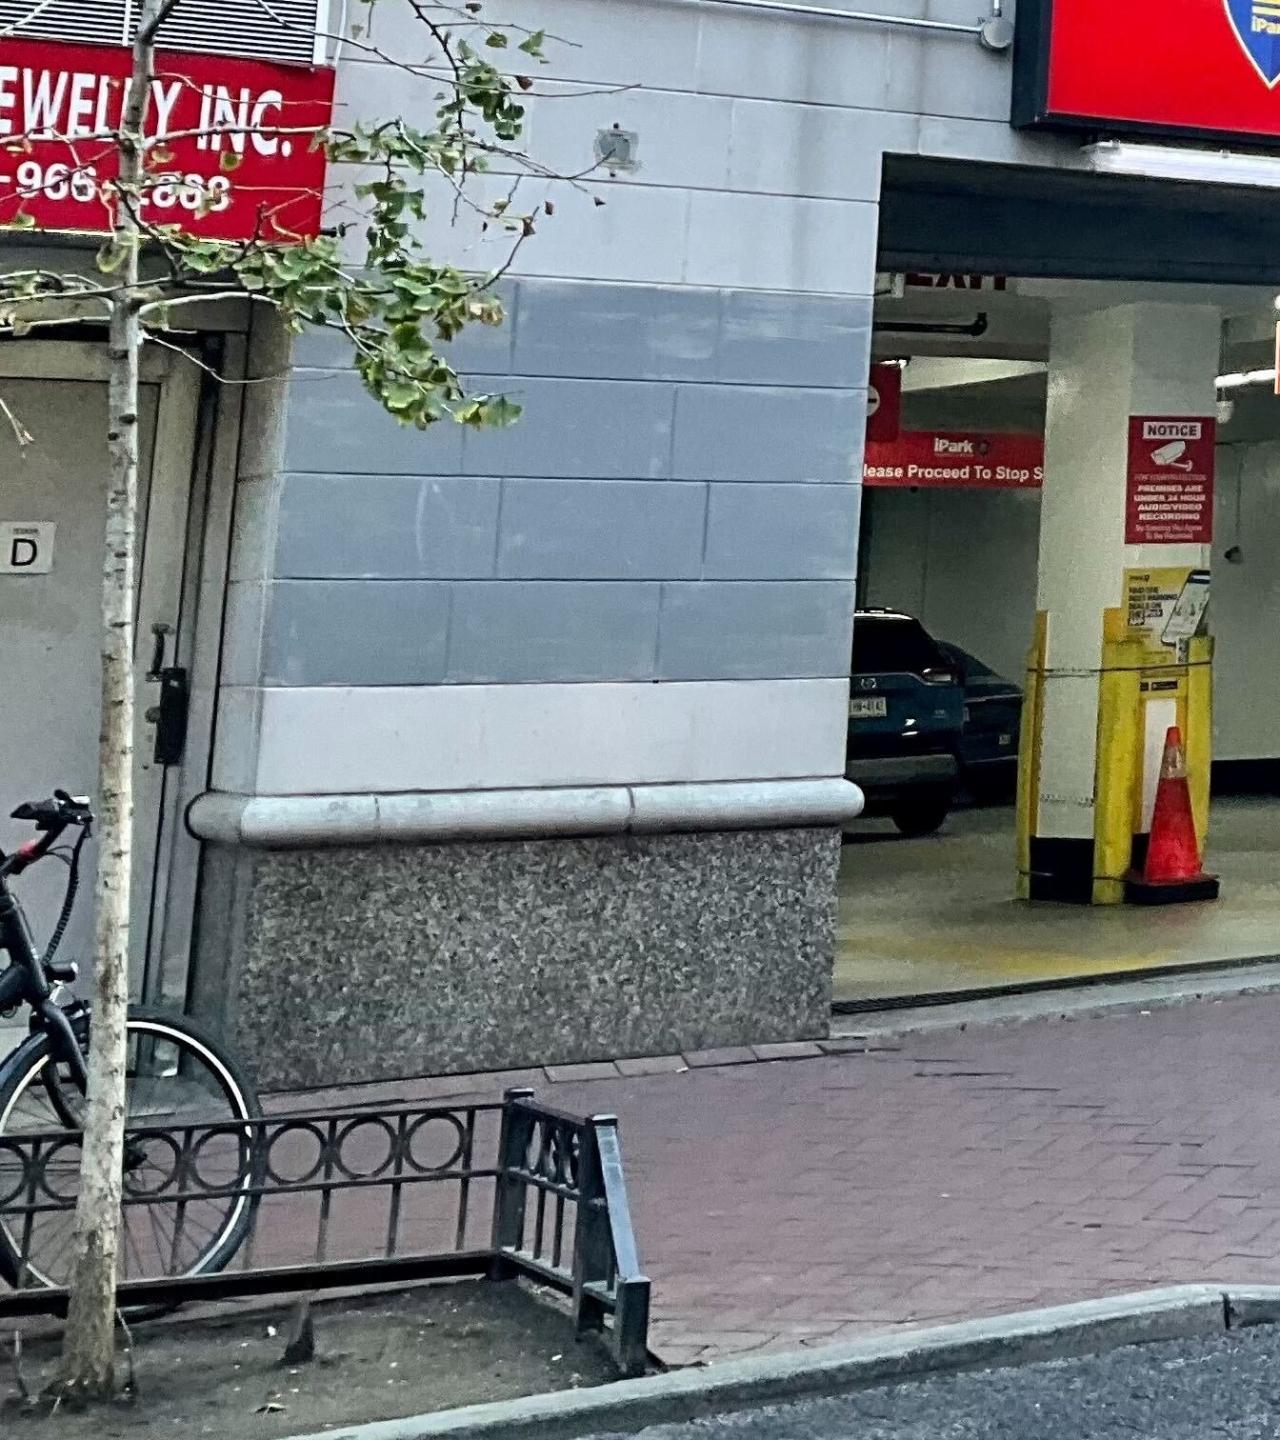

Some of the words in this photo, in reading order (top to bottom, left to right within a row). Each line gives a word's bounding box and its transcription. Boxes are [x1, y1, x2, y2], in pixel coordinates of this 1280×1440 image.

[0, 66, 182, 146] EWELY
[197, 84, 292, 157] INC.
[1147, 425, 1197, 437] NOTICE
[934, 438, 973, 453] iPark
[863, 463, 903, 478] lease
[908, 465, 970, 479] Proceed
[974, 465, 992, 479] To
[996, 466, 1030, 482] Stop
